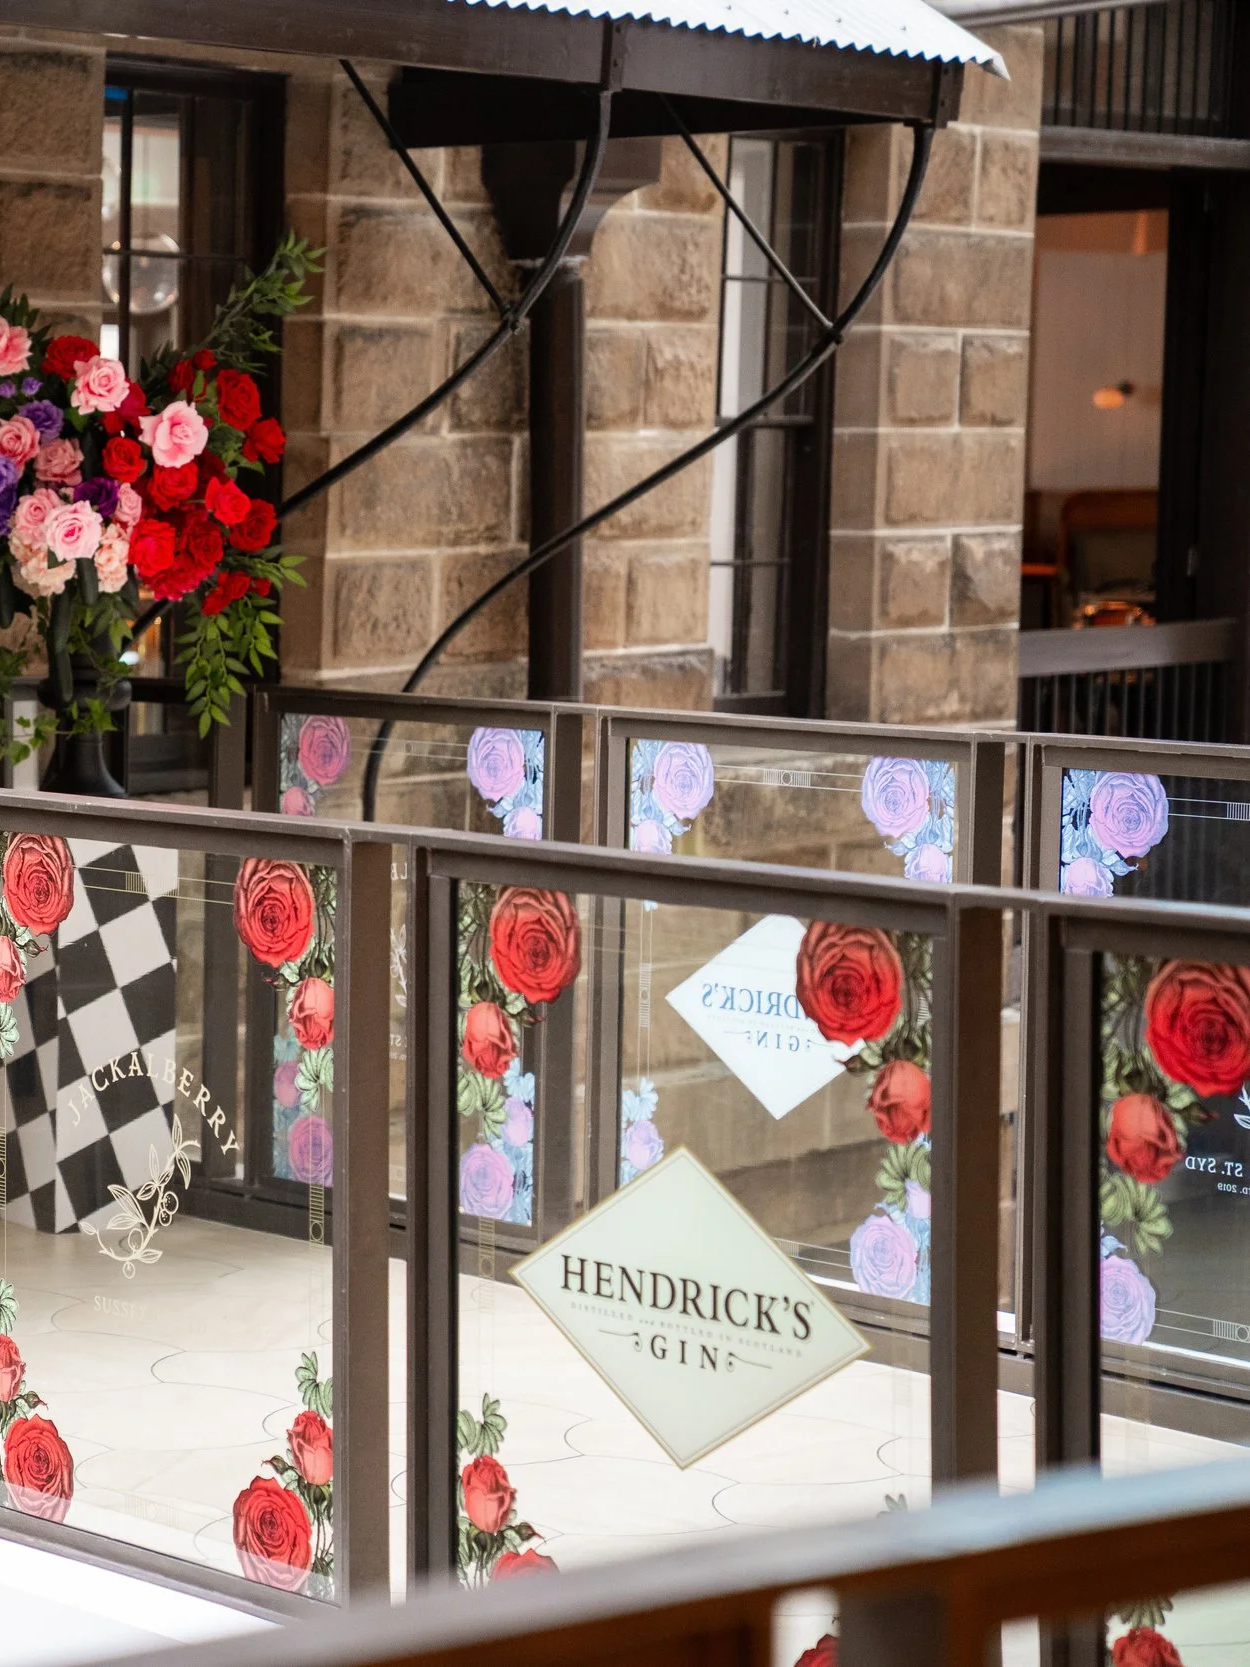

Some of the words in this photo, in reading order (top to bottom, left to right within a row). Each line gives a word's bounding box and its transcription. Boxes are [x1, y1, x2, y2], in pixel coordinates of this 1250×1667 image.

[67, 1051, 240, 1155] JACKALBERRY
[560, 1254, 812, 1341] HENDRICK'S
[650, 1334, 719, 1373] GIN
